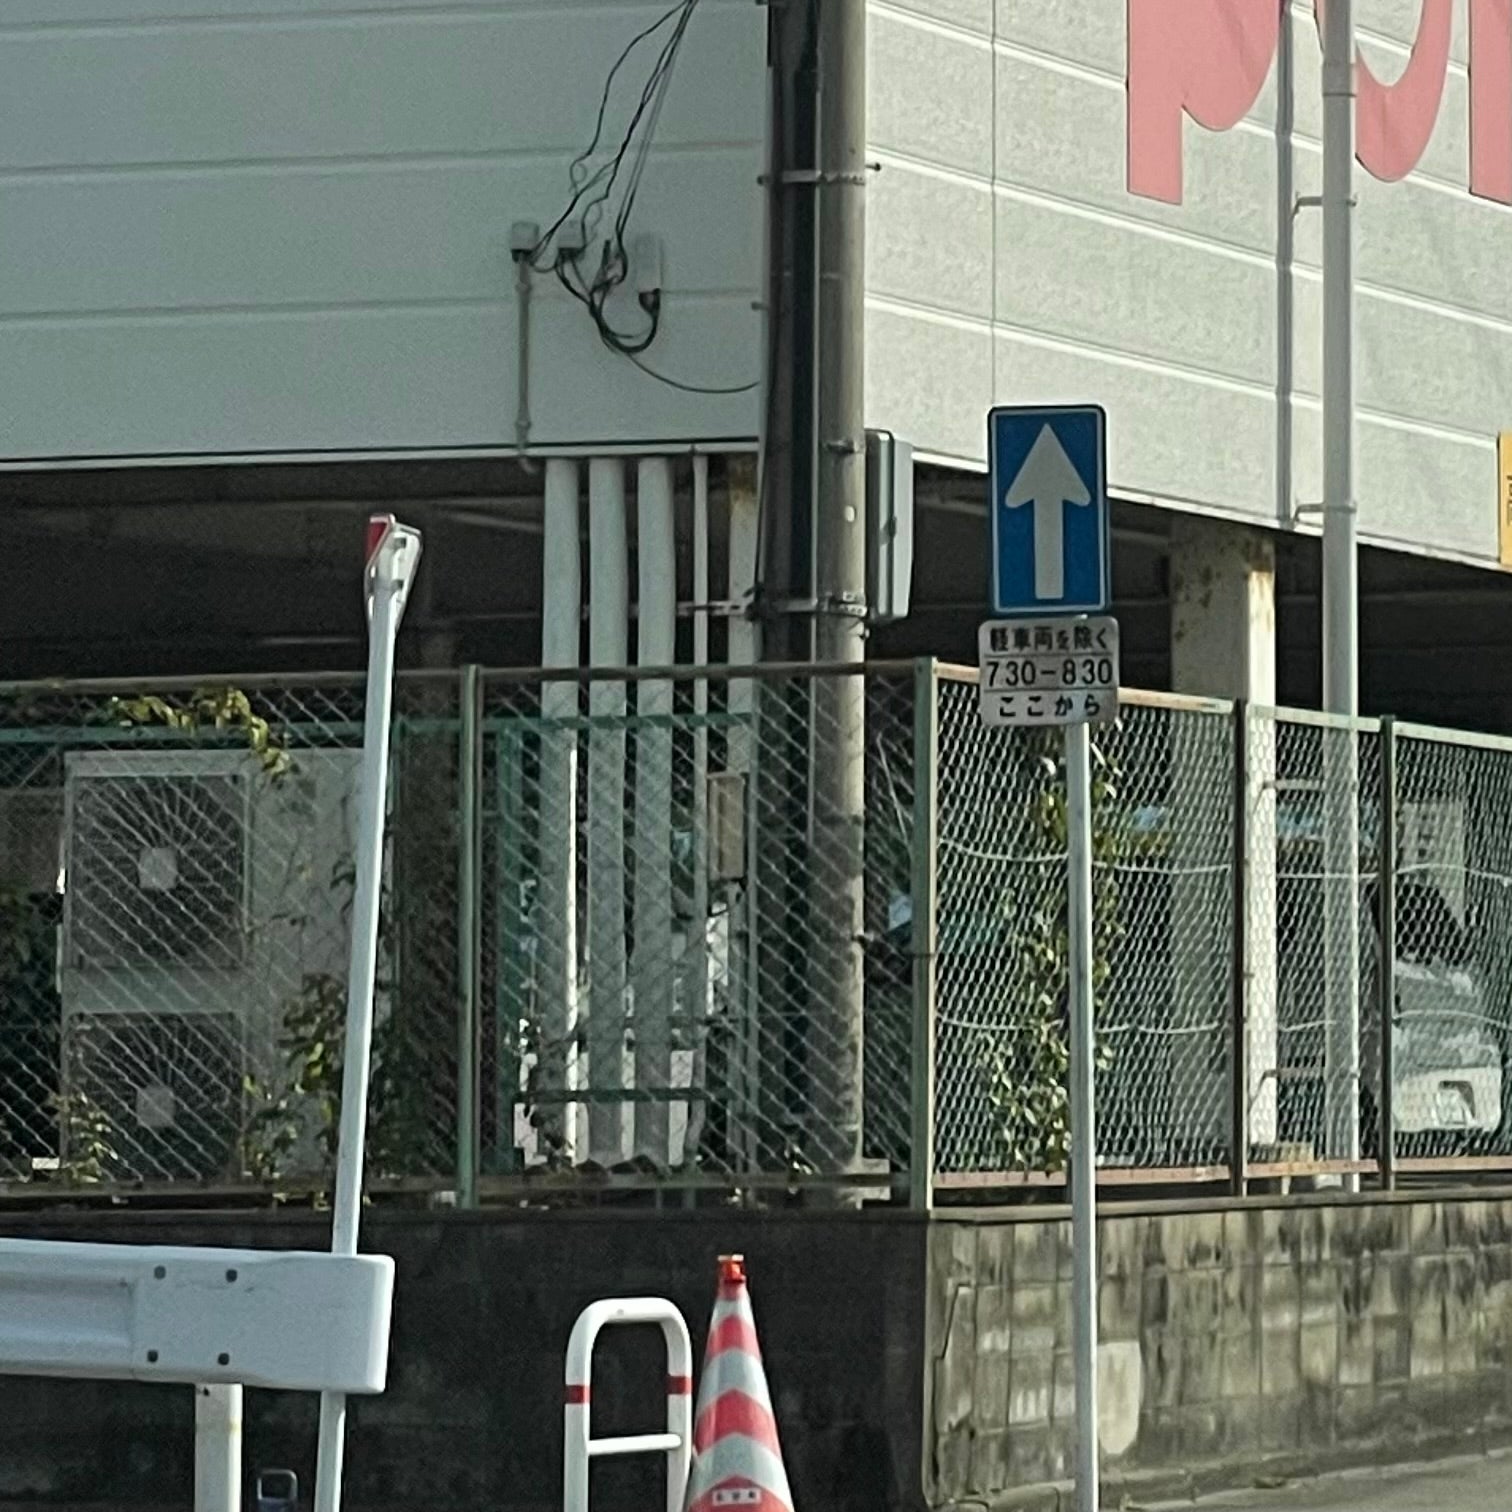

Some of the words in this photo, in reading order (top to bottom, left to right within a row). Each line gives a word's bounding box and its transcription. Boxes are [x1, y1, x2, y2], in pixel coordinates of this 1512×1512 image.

[990, 626, 1107, 652] 軽車両を除く
[999, 694, 1100, 717] ここから
